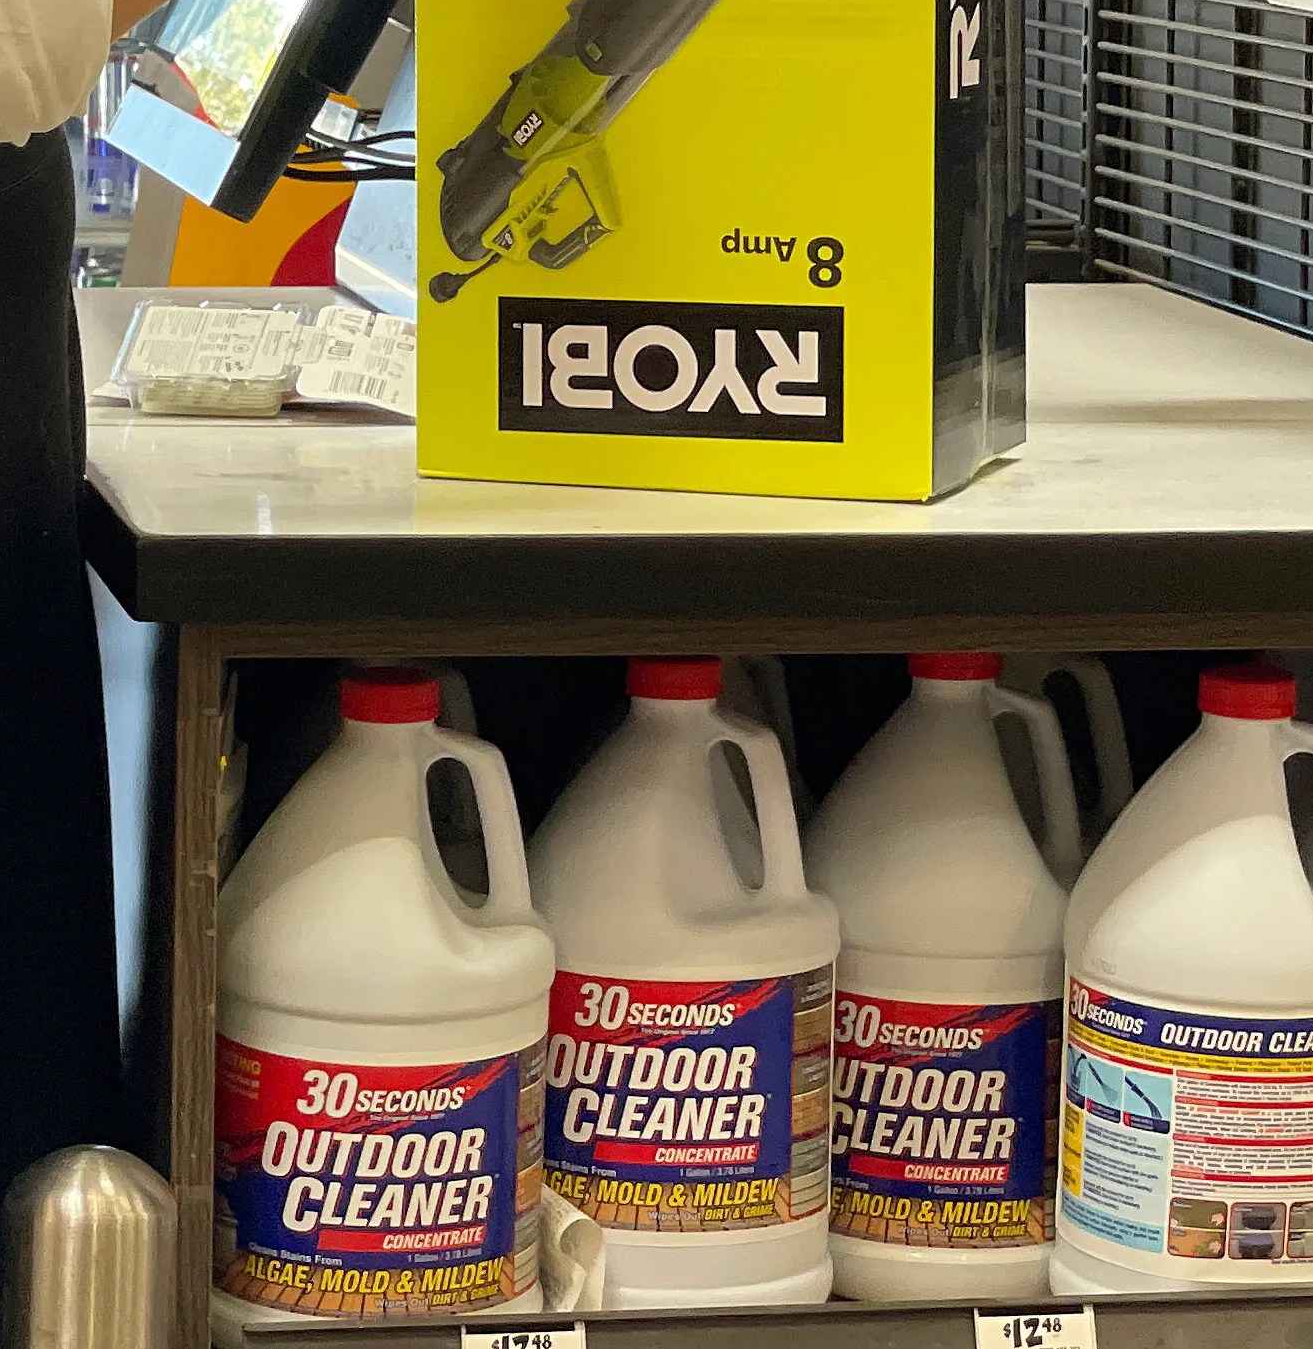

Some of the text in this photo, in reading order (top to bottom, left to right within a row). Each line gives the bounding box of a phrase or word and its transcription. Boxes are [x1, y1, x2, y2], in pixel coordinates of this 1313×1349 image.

[513, 113, 542, 146] RYOBI
[721, 229, 845, 288] 8 Amp
[523, 322, 827, 417] RYOBI
[575, 982, 736, 1030] 30 SECONDS
[835, 1000, 984, 1050] 30 SECONDS
[546, 1034, 756, 1092] OUTDOOR
[1160, 1022, 1264, 1054] OUTDOOR
[296, 1069, 358, 1118] 30
[355, 1086, 466, 1113] SECONDS
[563, 1088, 766, 1144] CLEANER
[261, 1121, 485, 1178] OUTDOOR
[655, 1144, 756, 1163] CONCENTRATE
[282, 1174, 494, 1232] CLEANER
[245, 1255, 505, 1294] ALGAE, MOLD & MILDEW
